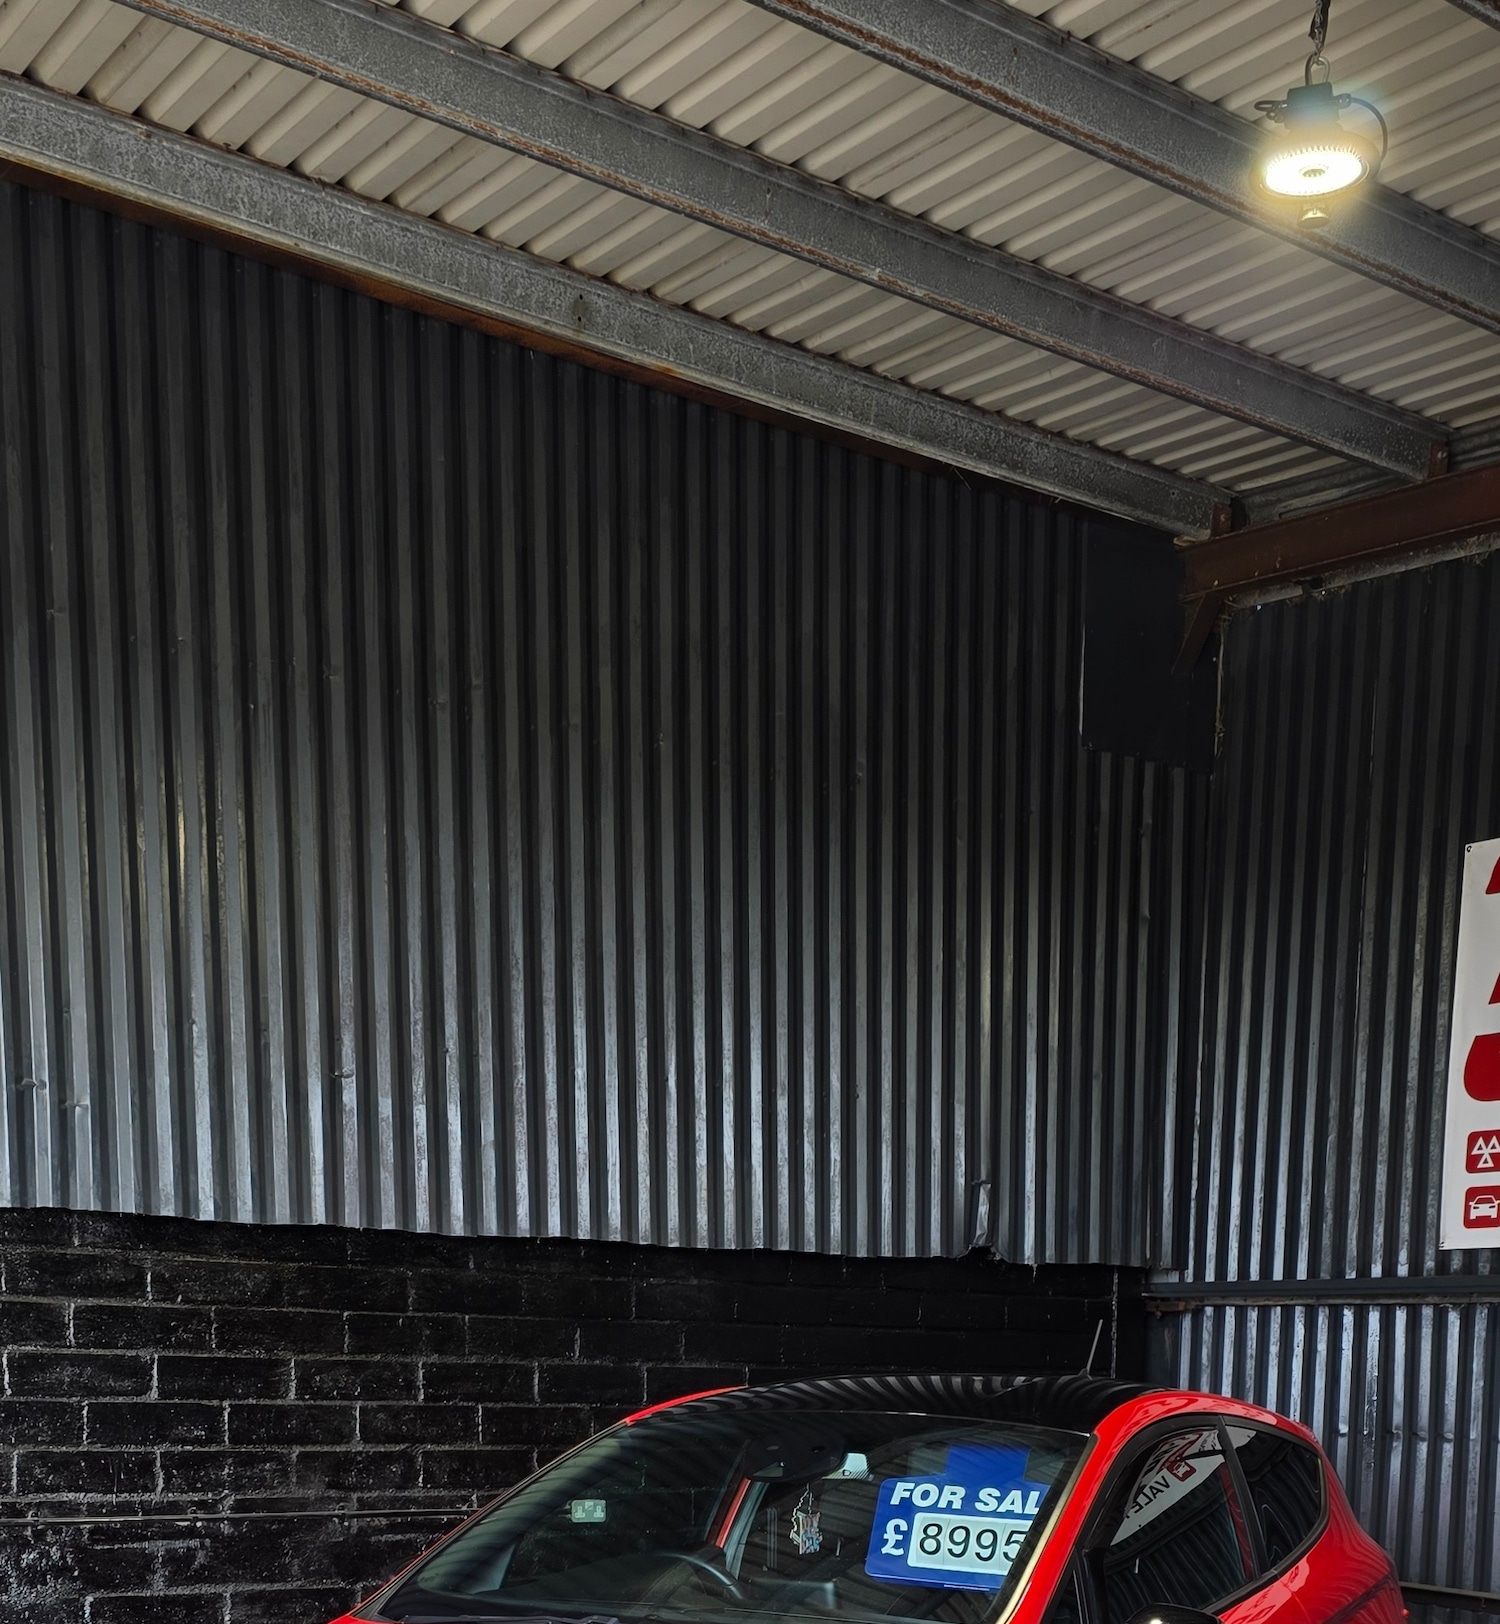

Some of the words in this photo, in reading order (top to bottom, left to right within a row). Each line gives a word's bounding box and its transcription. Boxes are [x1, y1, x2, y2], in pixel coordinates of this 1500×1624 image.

[890, 1482, 966, 1509] FOR
[881, 1518, 908, 1556] £
[919, 1523, 1029, 1562] 8995
